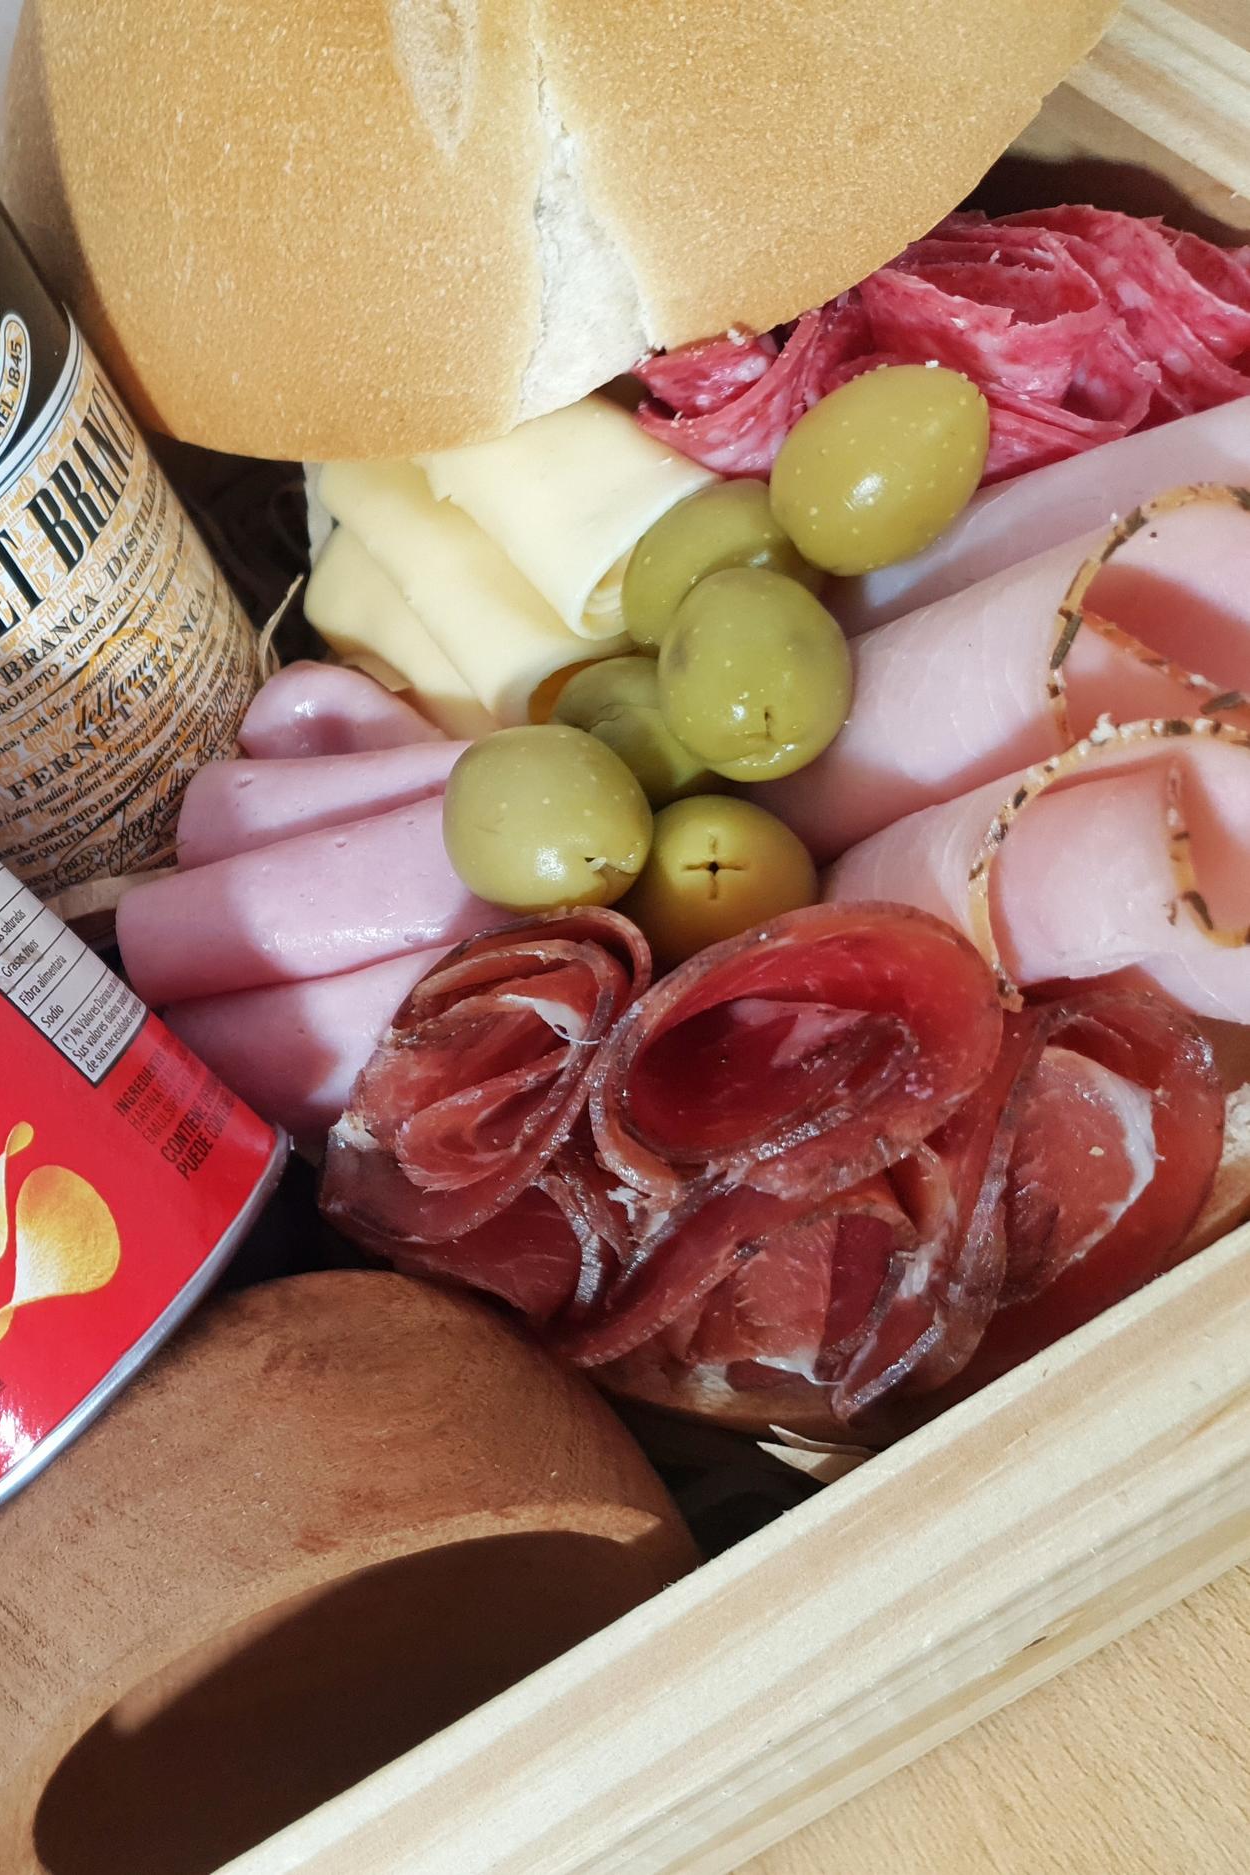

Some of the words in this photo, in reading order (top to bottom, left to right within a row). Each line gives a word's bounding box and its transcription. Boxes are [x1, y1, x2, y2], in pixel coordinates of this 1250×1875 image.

[7, 340, 23, 390] 1845
[65, 615, 107, 661] VICINO
[106, 585, 132, 622] ALLA
[129, 545, 154, 590] CHIESA
[8, 702, 135, 801] FERNET
[135, 589, 207, 701] BRANCA
[28, 716, 49, 737] soli
[49, 701, 70, 723] che
[69, 651, 124, 708] posseggono
[75, 692, 107, 736] del
[29, 802, 100, 849] CONOSCIUTO
[1, 907, 27, 936] saturadas
[1, 954, 26, 979] Grasas
[19, 984, 41, 1007] Fibra
[38, 953, 68, 989] alimentaria
[40, 1003, 64, 1029] Sodio
[77, 1006, 101, 1031] Valores
[72, 1041, 90, 1062] Sus
[87, 1020, 109, 1046] valores
[85, 1057, 100, 1074] de
[98, 1049, 110, 1065] sus
[106, 1014, 133, 1053] necesidades
[161, 1097, 209, 1164] CONTIENE
[176, 1133, 215, 1181] PUEDE
